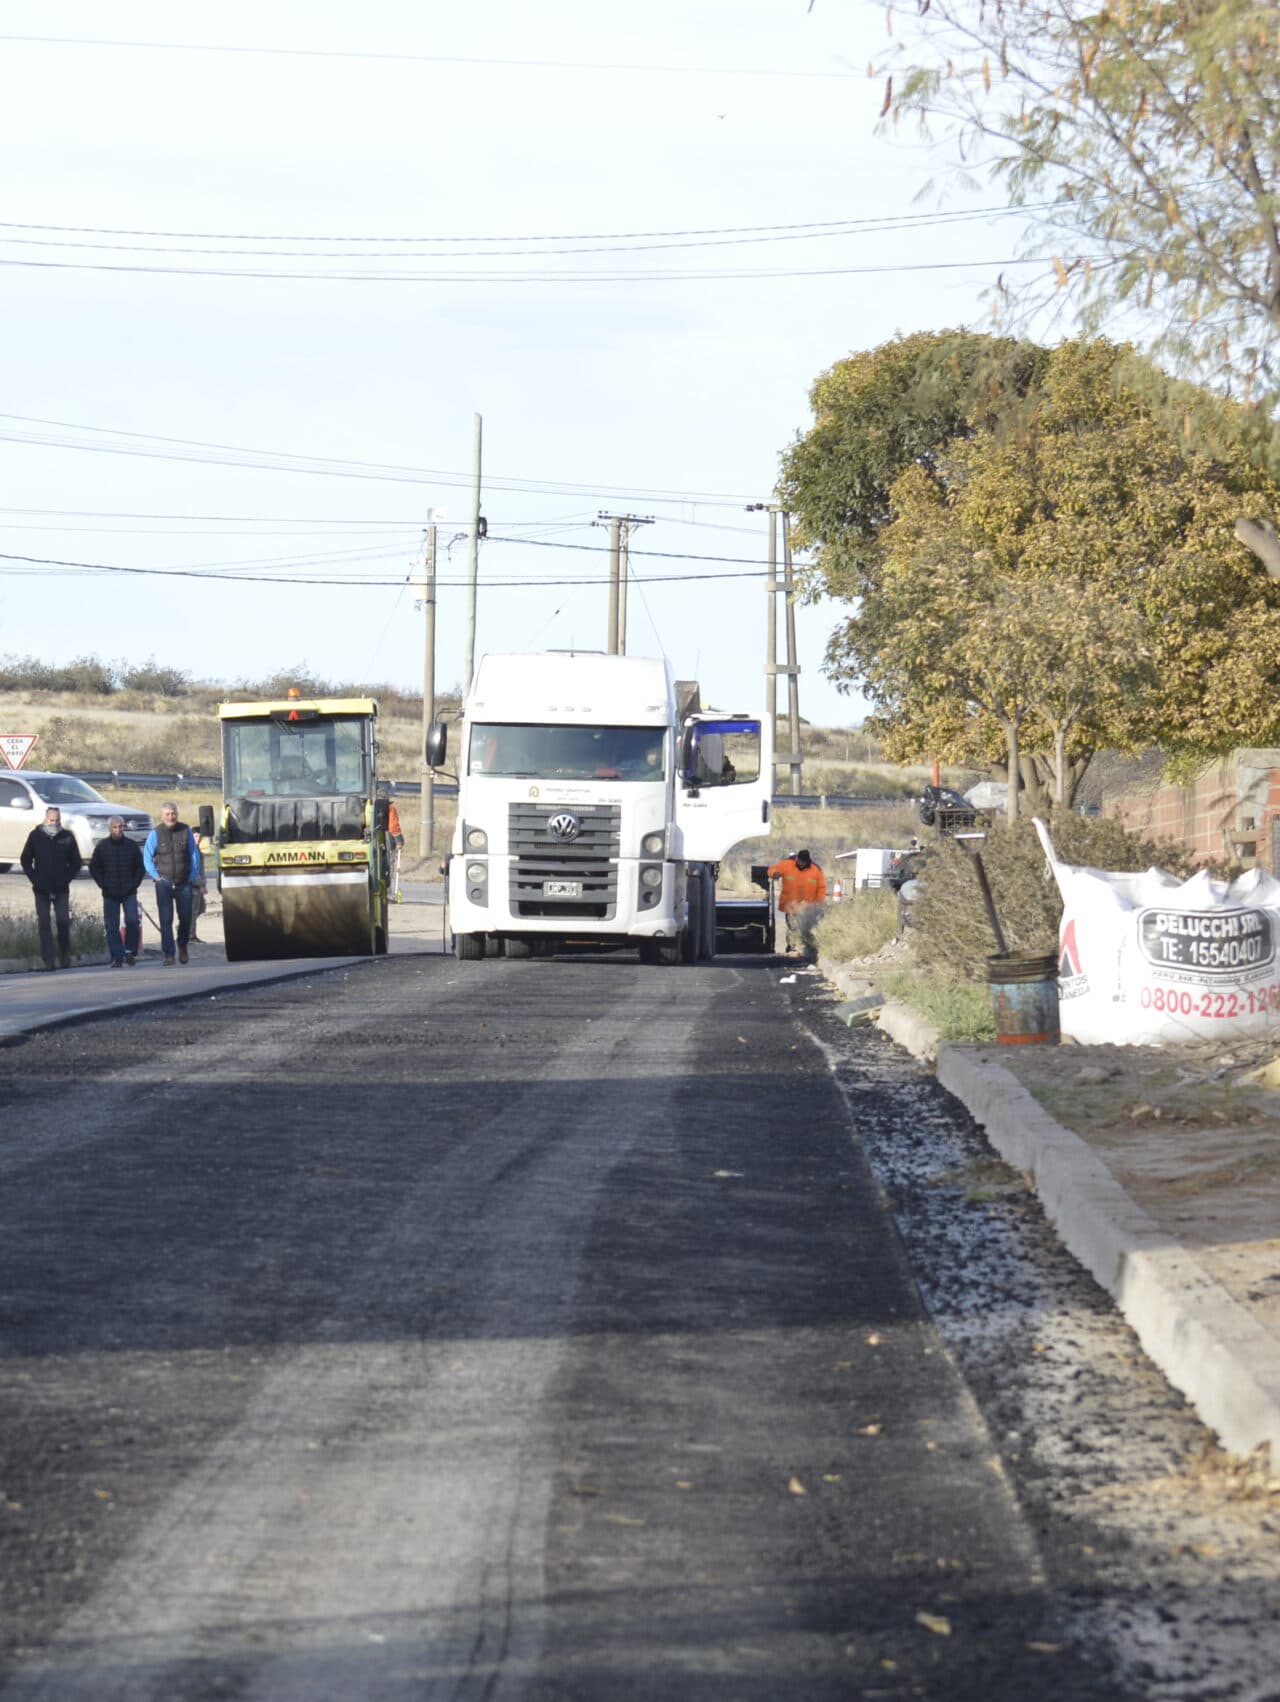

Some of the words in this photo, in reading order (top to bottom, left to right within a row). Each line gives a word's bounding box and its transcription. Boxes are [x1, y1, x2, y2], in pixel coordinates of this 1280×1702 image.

[267, 851, 326, 863] AMMANN
[1156, 914, 1238, 937] DELUCCHI
[1240, 913, 1262, 935] SRL
[1160, 936, 1183, 961] TE:
[1189, 936, 1262, 966] 15540407
